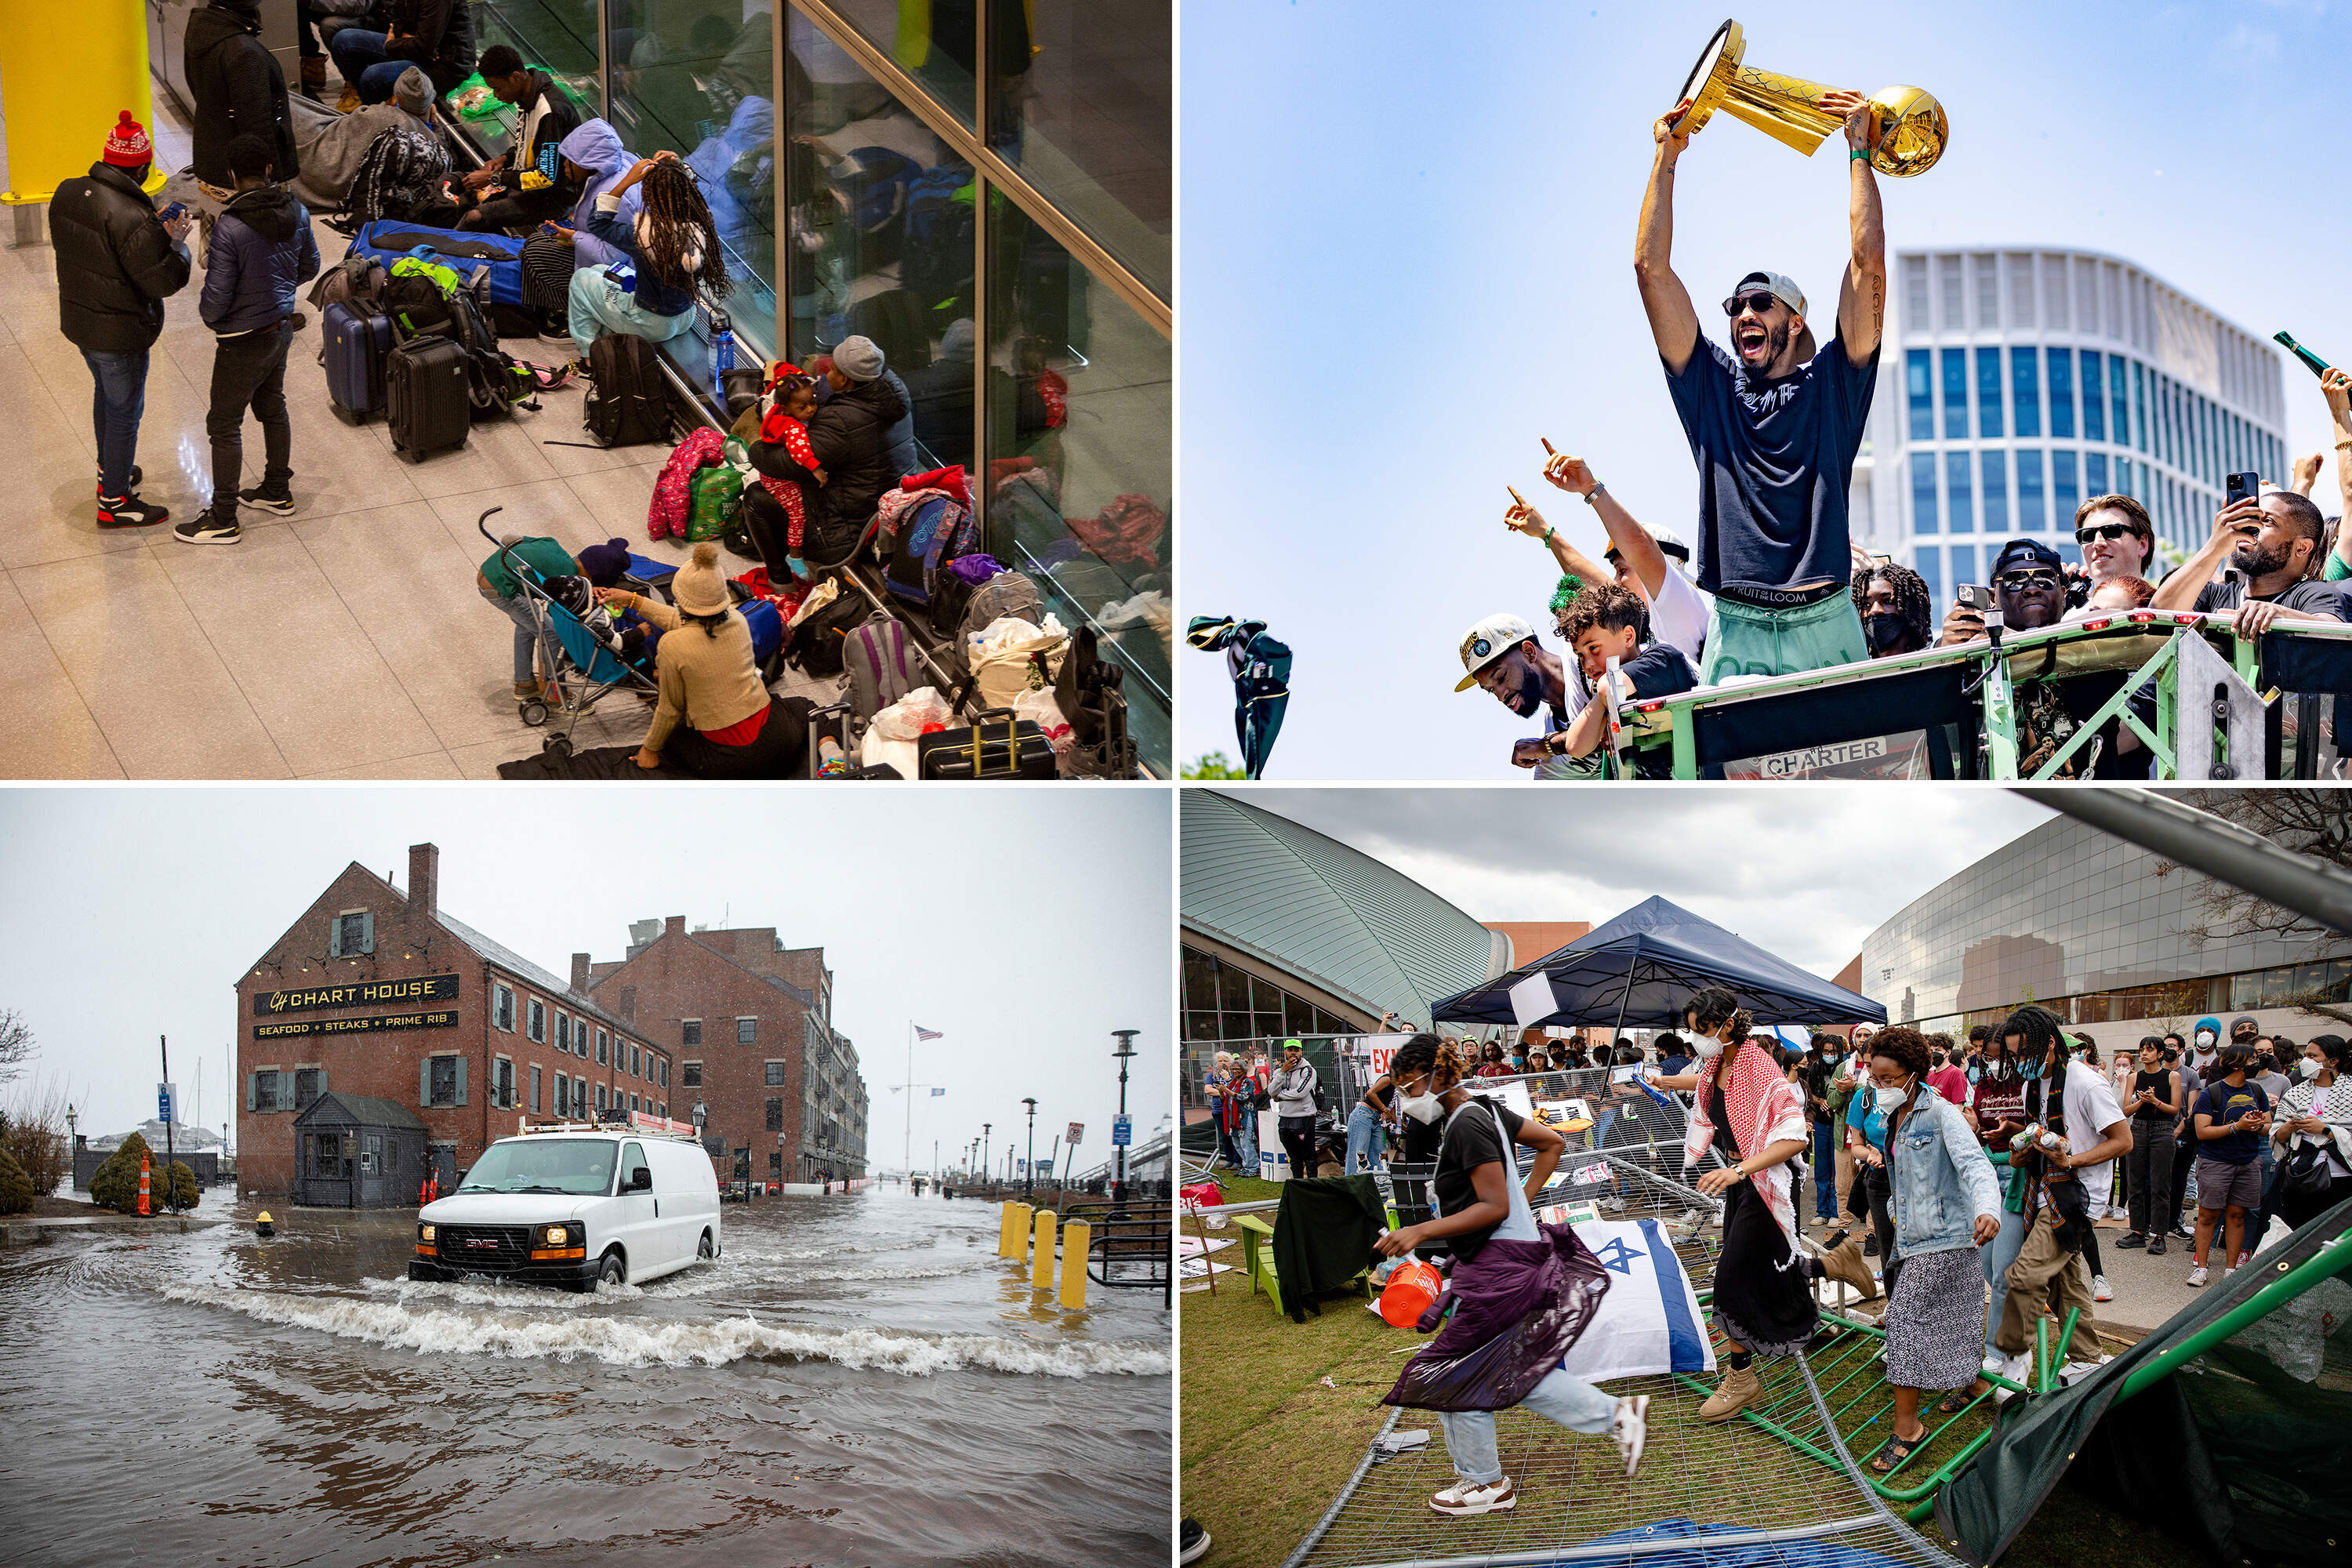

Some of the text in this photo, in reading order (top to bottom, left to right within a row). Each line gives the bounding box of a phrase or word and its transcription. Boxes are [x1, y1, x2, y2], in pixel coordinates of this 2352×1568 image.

[1733, 585, 1759, 599] FRUIT
[1769, 592, 1807, 603] LOOM
[1767, 741, 1882, 775] CHARTER
[291, 988, 356, 1007] CHART
[364, 981, 436, 1000] HOUSE
[259, 1014, 448, 1036] SEAFOOD STEAKS PRIME RIB
[466, 1239, 498, 1249] GMC
